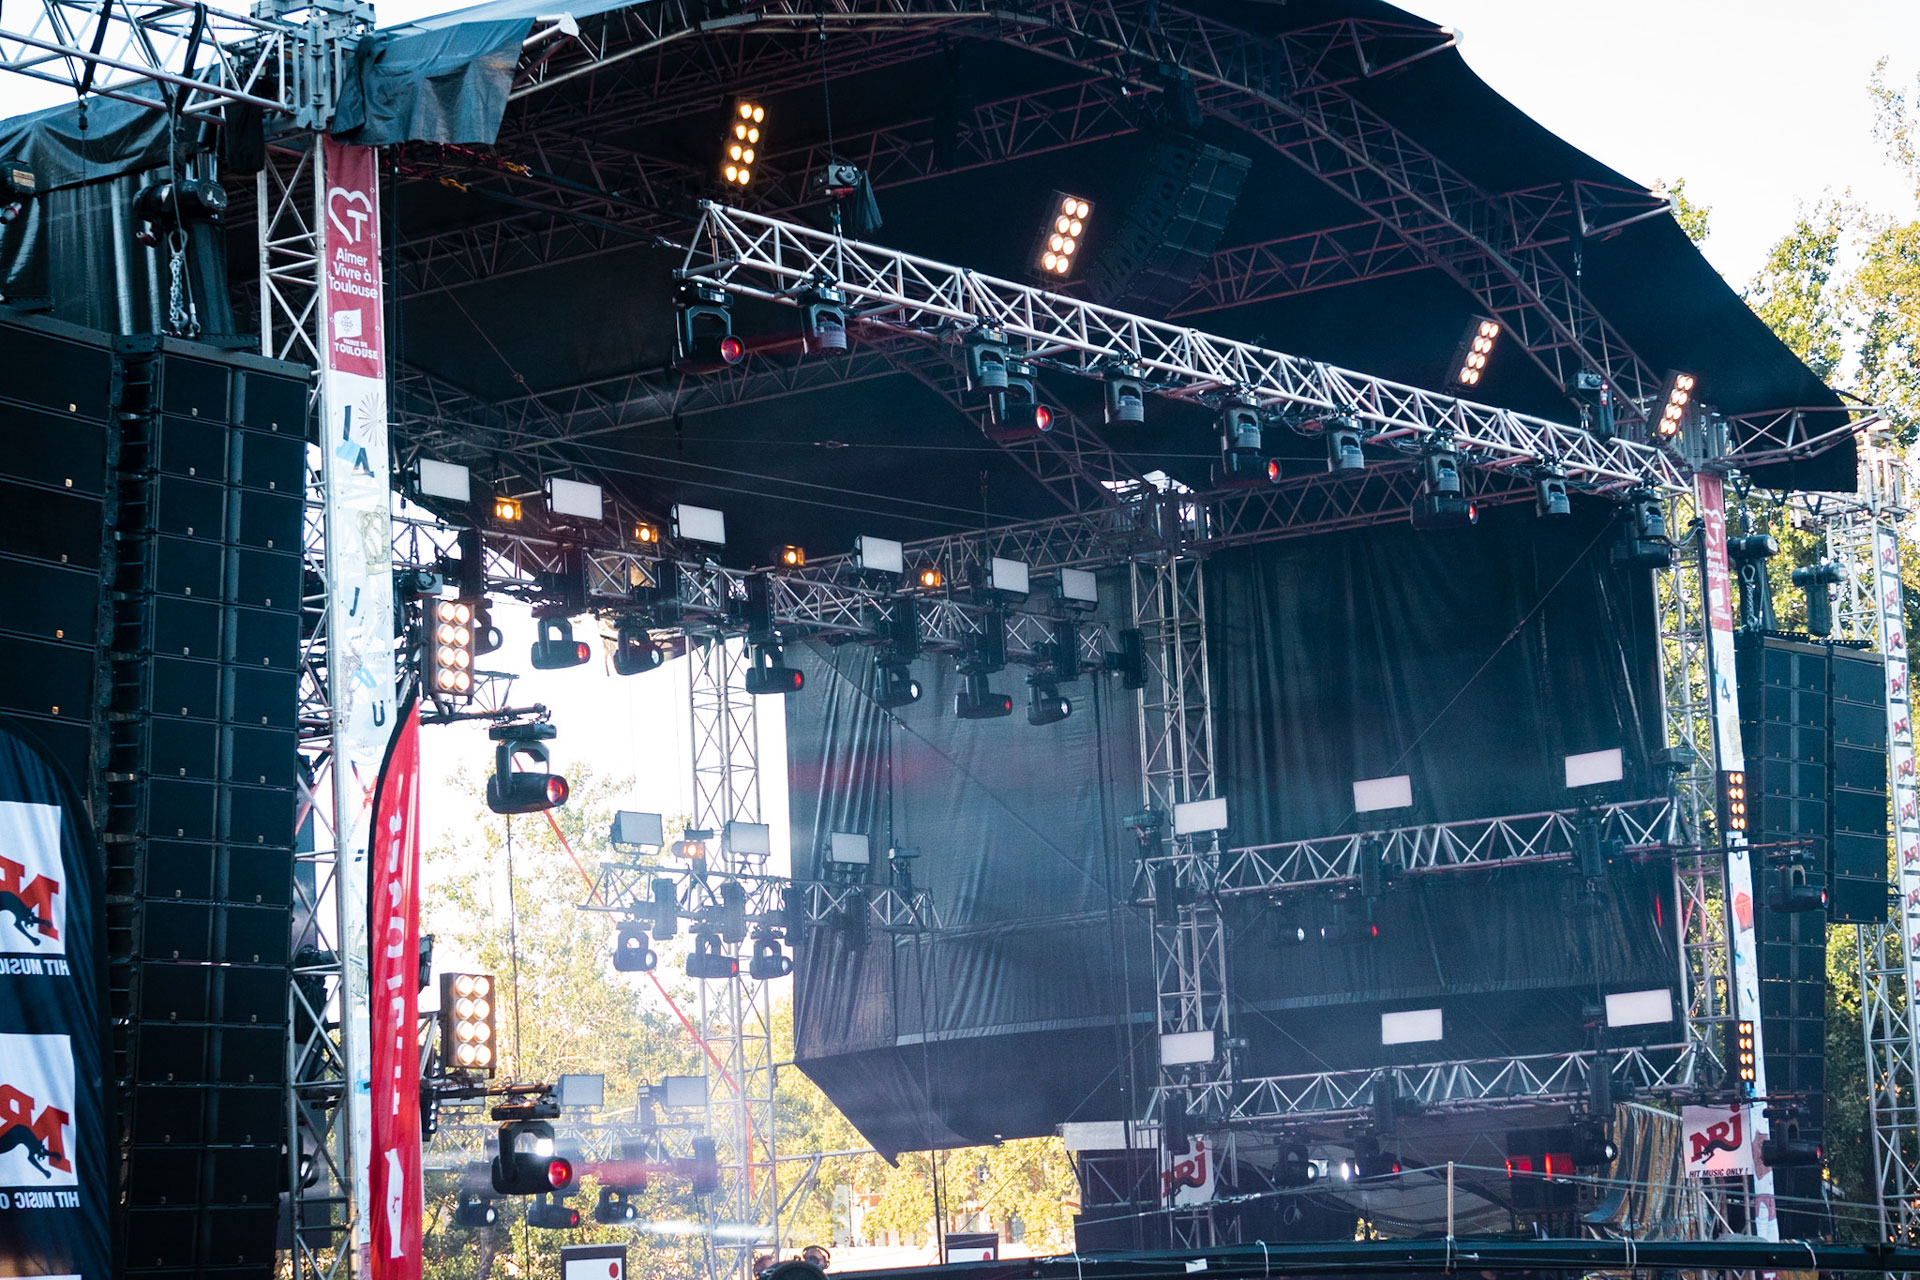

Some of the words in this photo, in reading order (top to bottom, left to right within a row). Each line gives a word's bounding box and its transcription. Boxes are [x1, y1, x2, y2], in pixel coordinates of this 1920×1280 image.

[336, 247, 368, 267] Aimer
[333, 261, 362, 281] Vivre
[363, 268, 372, 283] à
[328, 275, 378, 299] Toulouse
[334, 342, 379, 360] TOULOUSE
[1689, 1102, 1743, 1163] NRJ
[1689, 1170, 1701, 1178] HIT
[1702, 1168, 1725, 1177] MUSIC
[1726, 1168, 1743, 1177] ONLY
